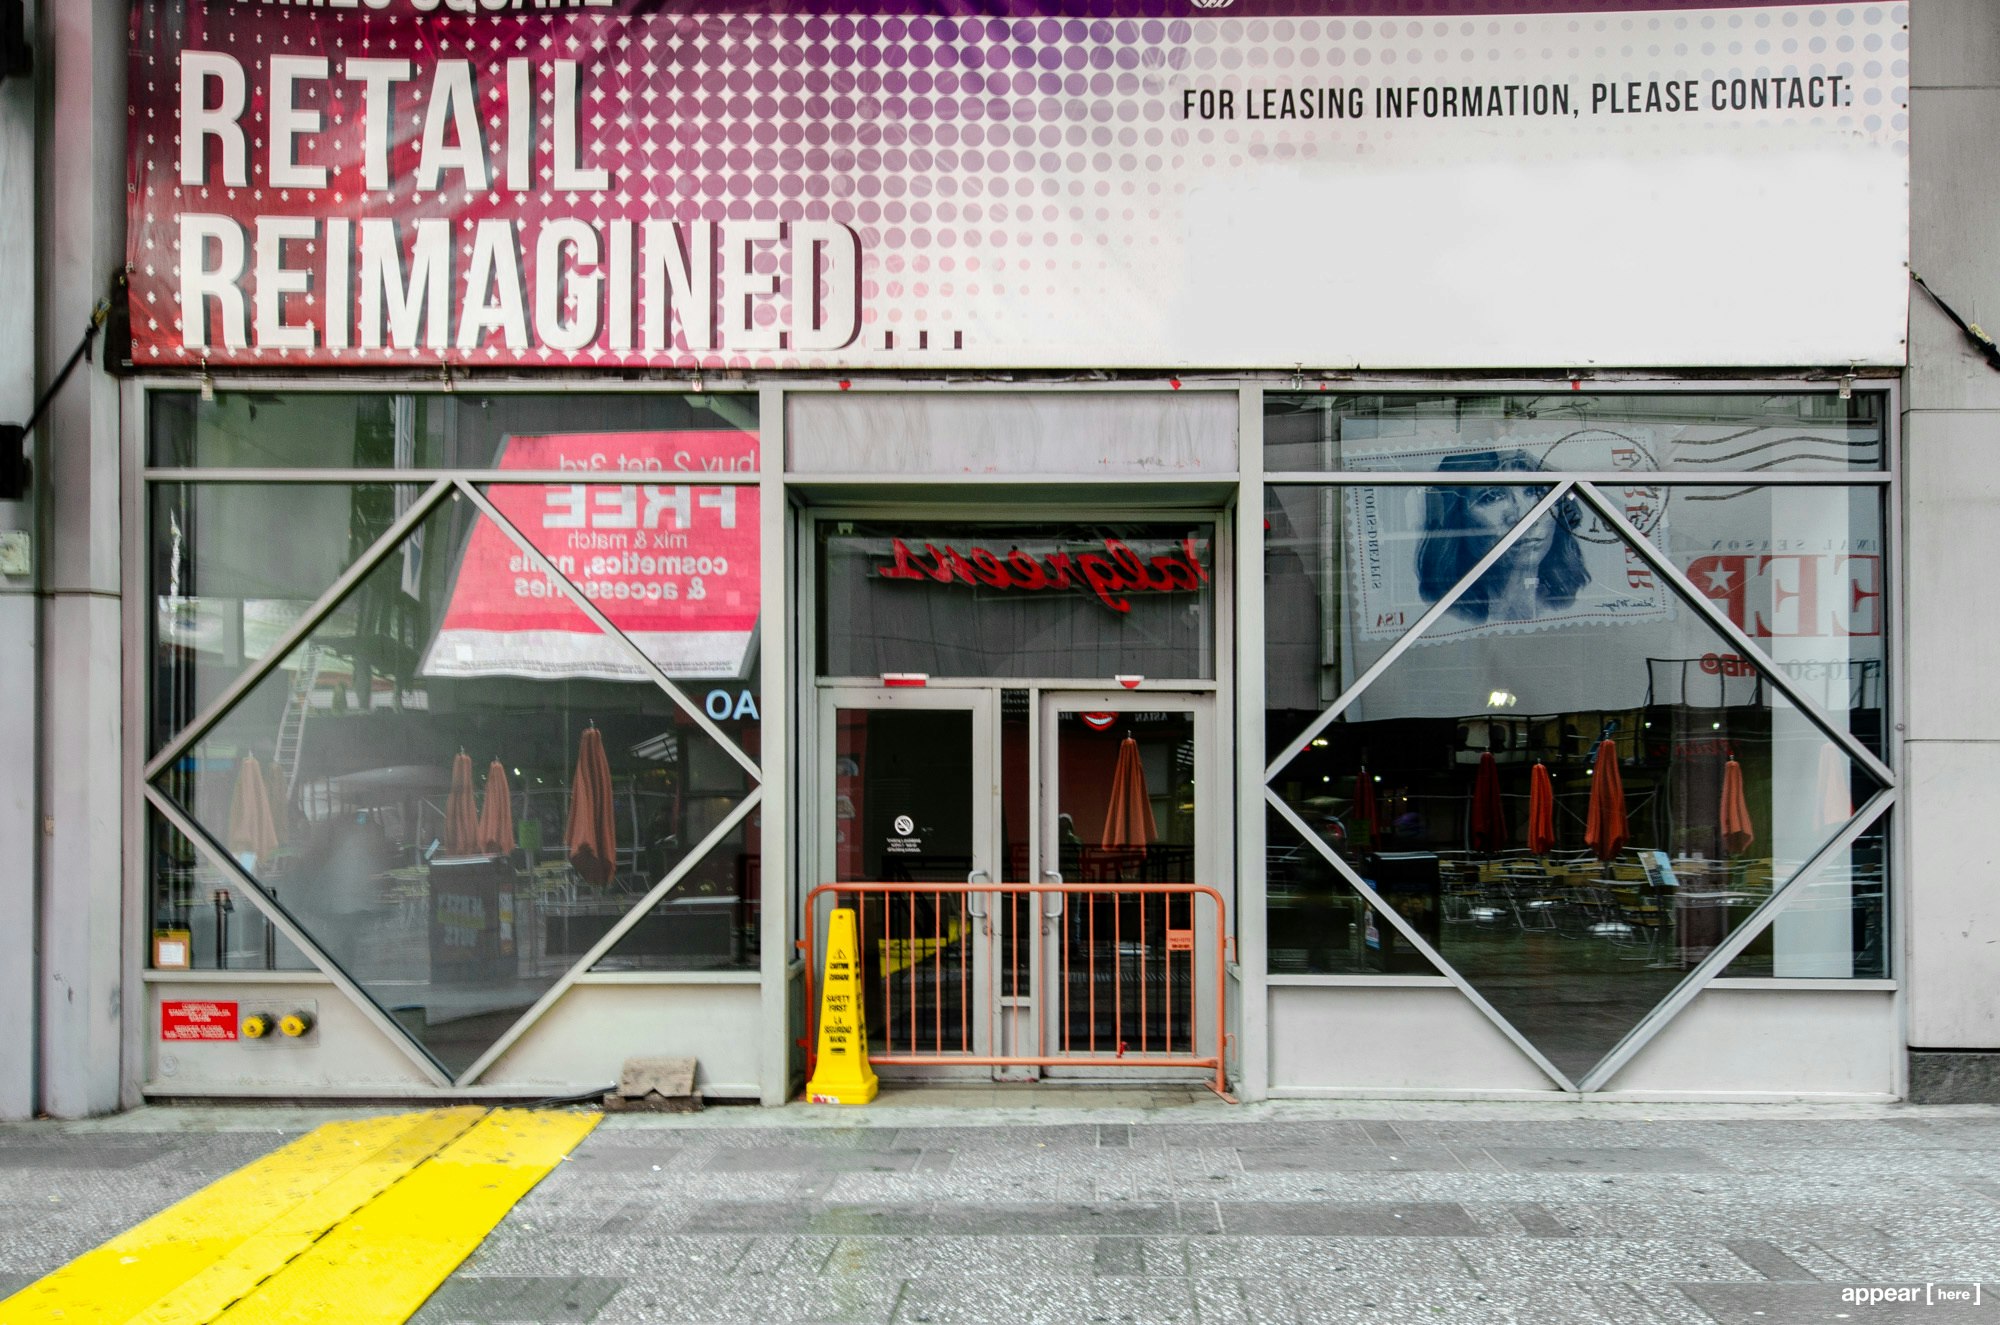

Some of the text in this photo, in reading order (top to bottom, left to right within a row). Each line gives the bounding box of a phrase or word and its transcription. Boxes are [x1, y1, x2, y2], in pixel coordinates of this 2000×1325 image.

[180, 50, 616, 192] RETAIL
[1183, 76, 1852, 120] FOR LEASING INFORMATION, PLEASE CONTACT:
